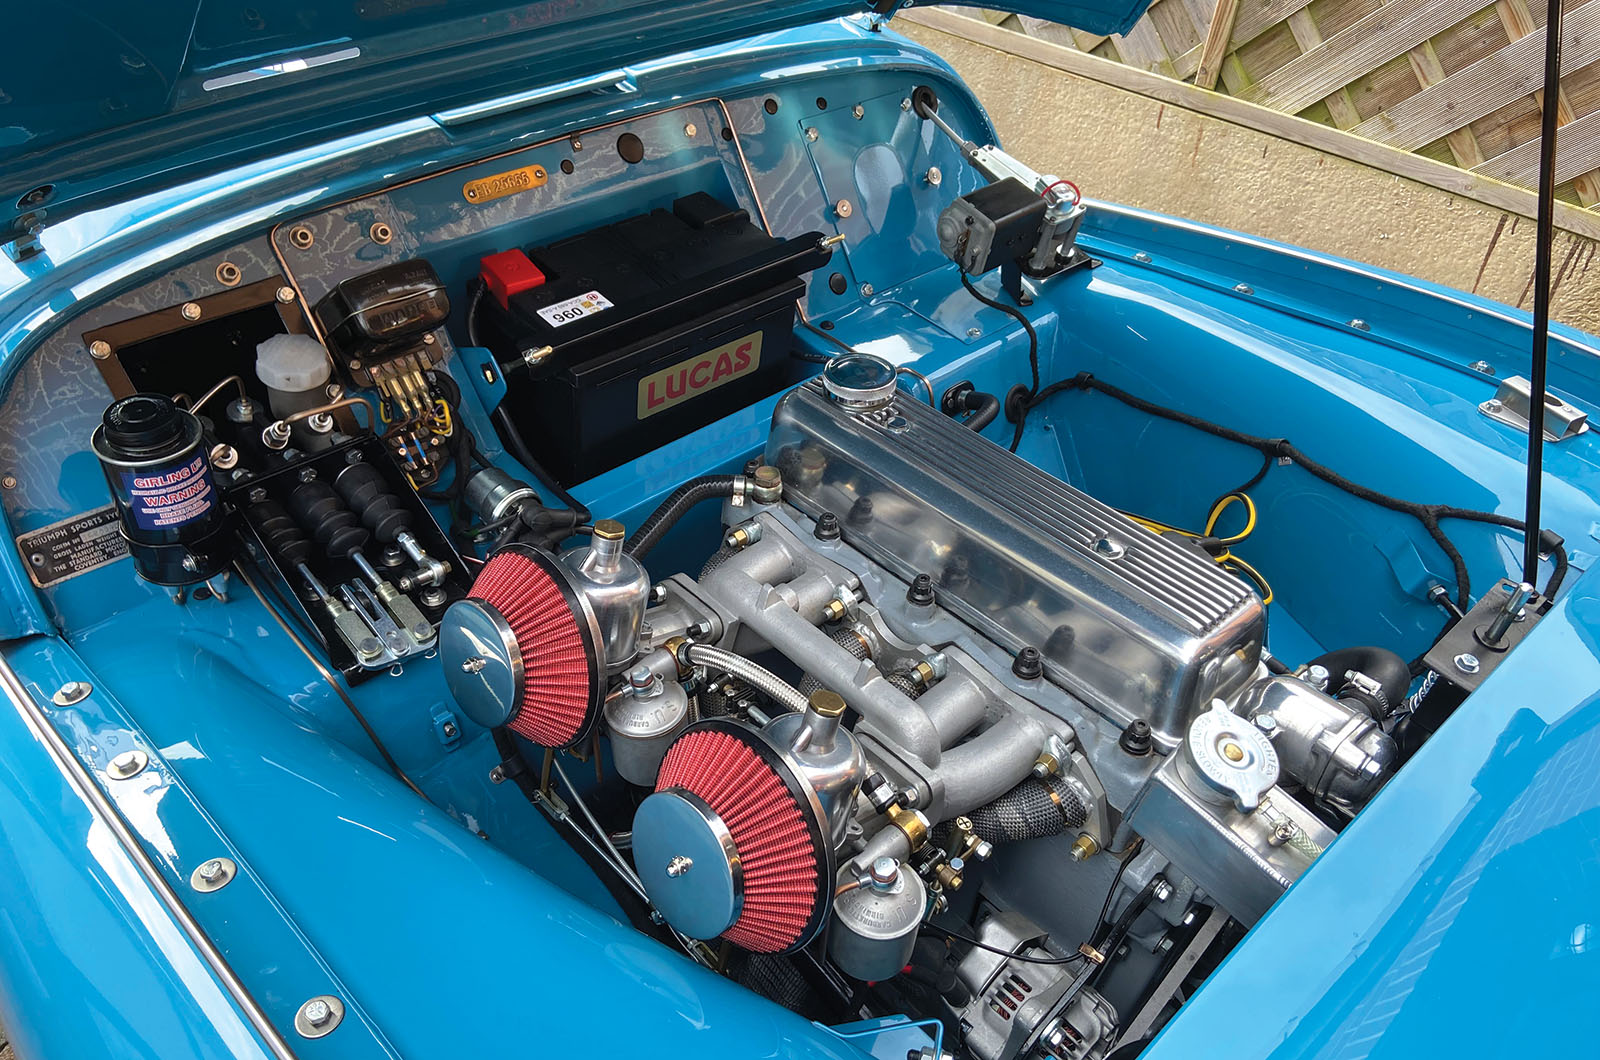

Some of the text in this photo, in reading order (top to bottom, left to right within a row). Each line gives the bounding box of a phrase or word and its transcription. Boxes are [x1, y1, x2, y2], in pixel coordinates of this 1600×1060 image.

[647, 341, 753, 410] LUCAS
[133, 467, 192, 489] GIRLING
[143, 478, 206, 508] WARNING
[160, 508, 186, 519] BRAKE
[27, 529, 68, 548] TRIUMPH
[70, 516, 103, 533] SPORTS
[53, 548, 73, 560] GROSS
[74, 541, 94, 552] LADEN
[96, 532, 118, 543] WEIGHT
[53, 542, 125, 573] THE STANDARD MOTO
